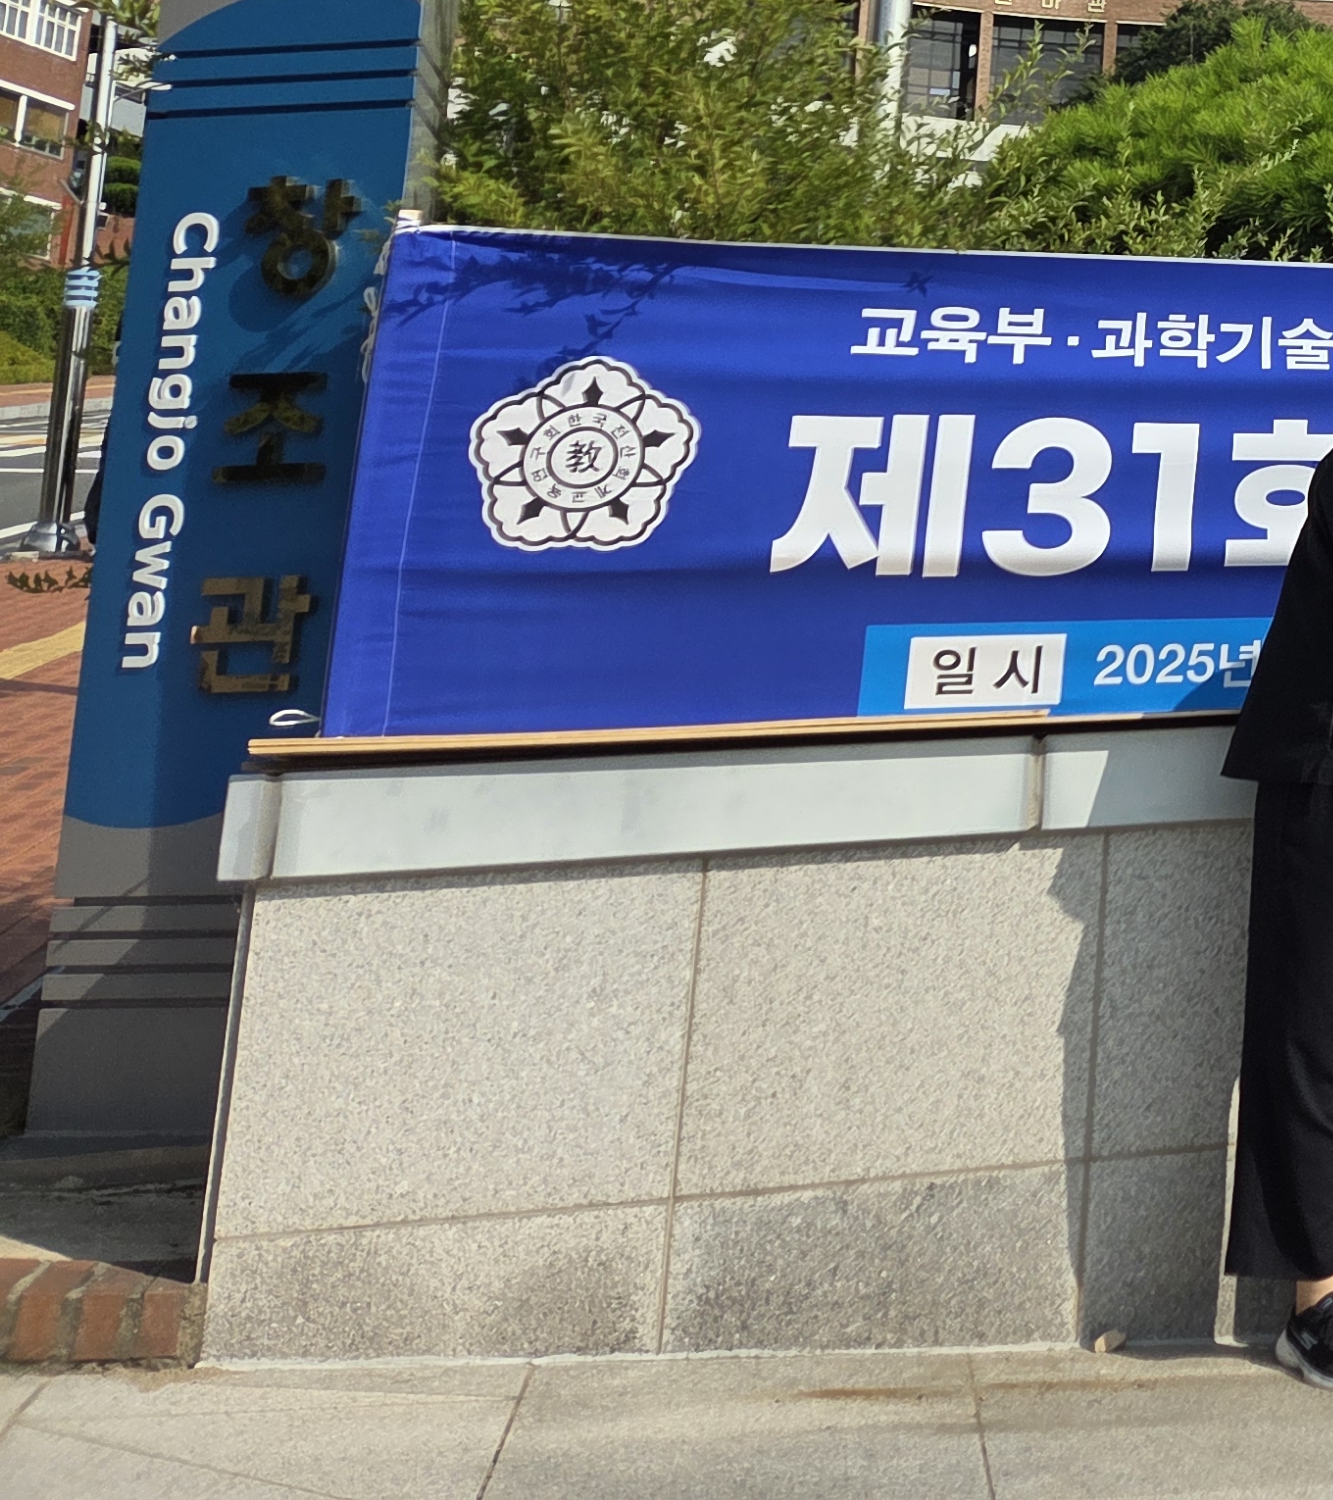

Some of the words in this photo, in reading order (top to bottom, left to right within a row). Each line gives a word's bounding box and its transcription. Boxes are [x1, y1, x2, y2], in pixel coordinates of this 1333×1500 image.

[147, 211, 220, 471] Changjo
[565, 440, 602, 473] 教
[121, 493, 185, 670] Gwan
[1094, 639, 1262, 689] 2025년
